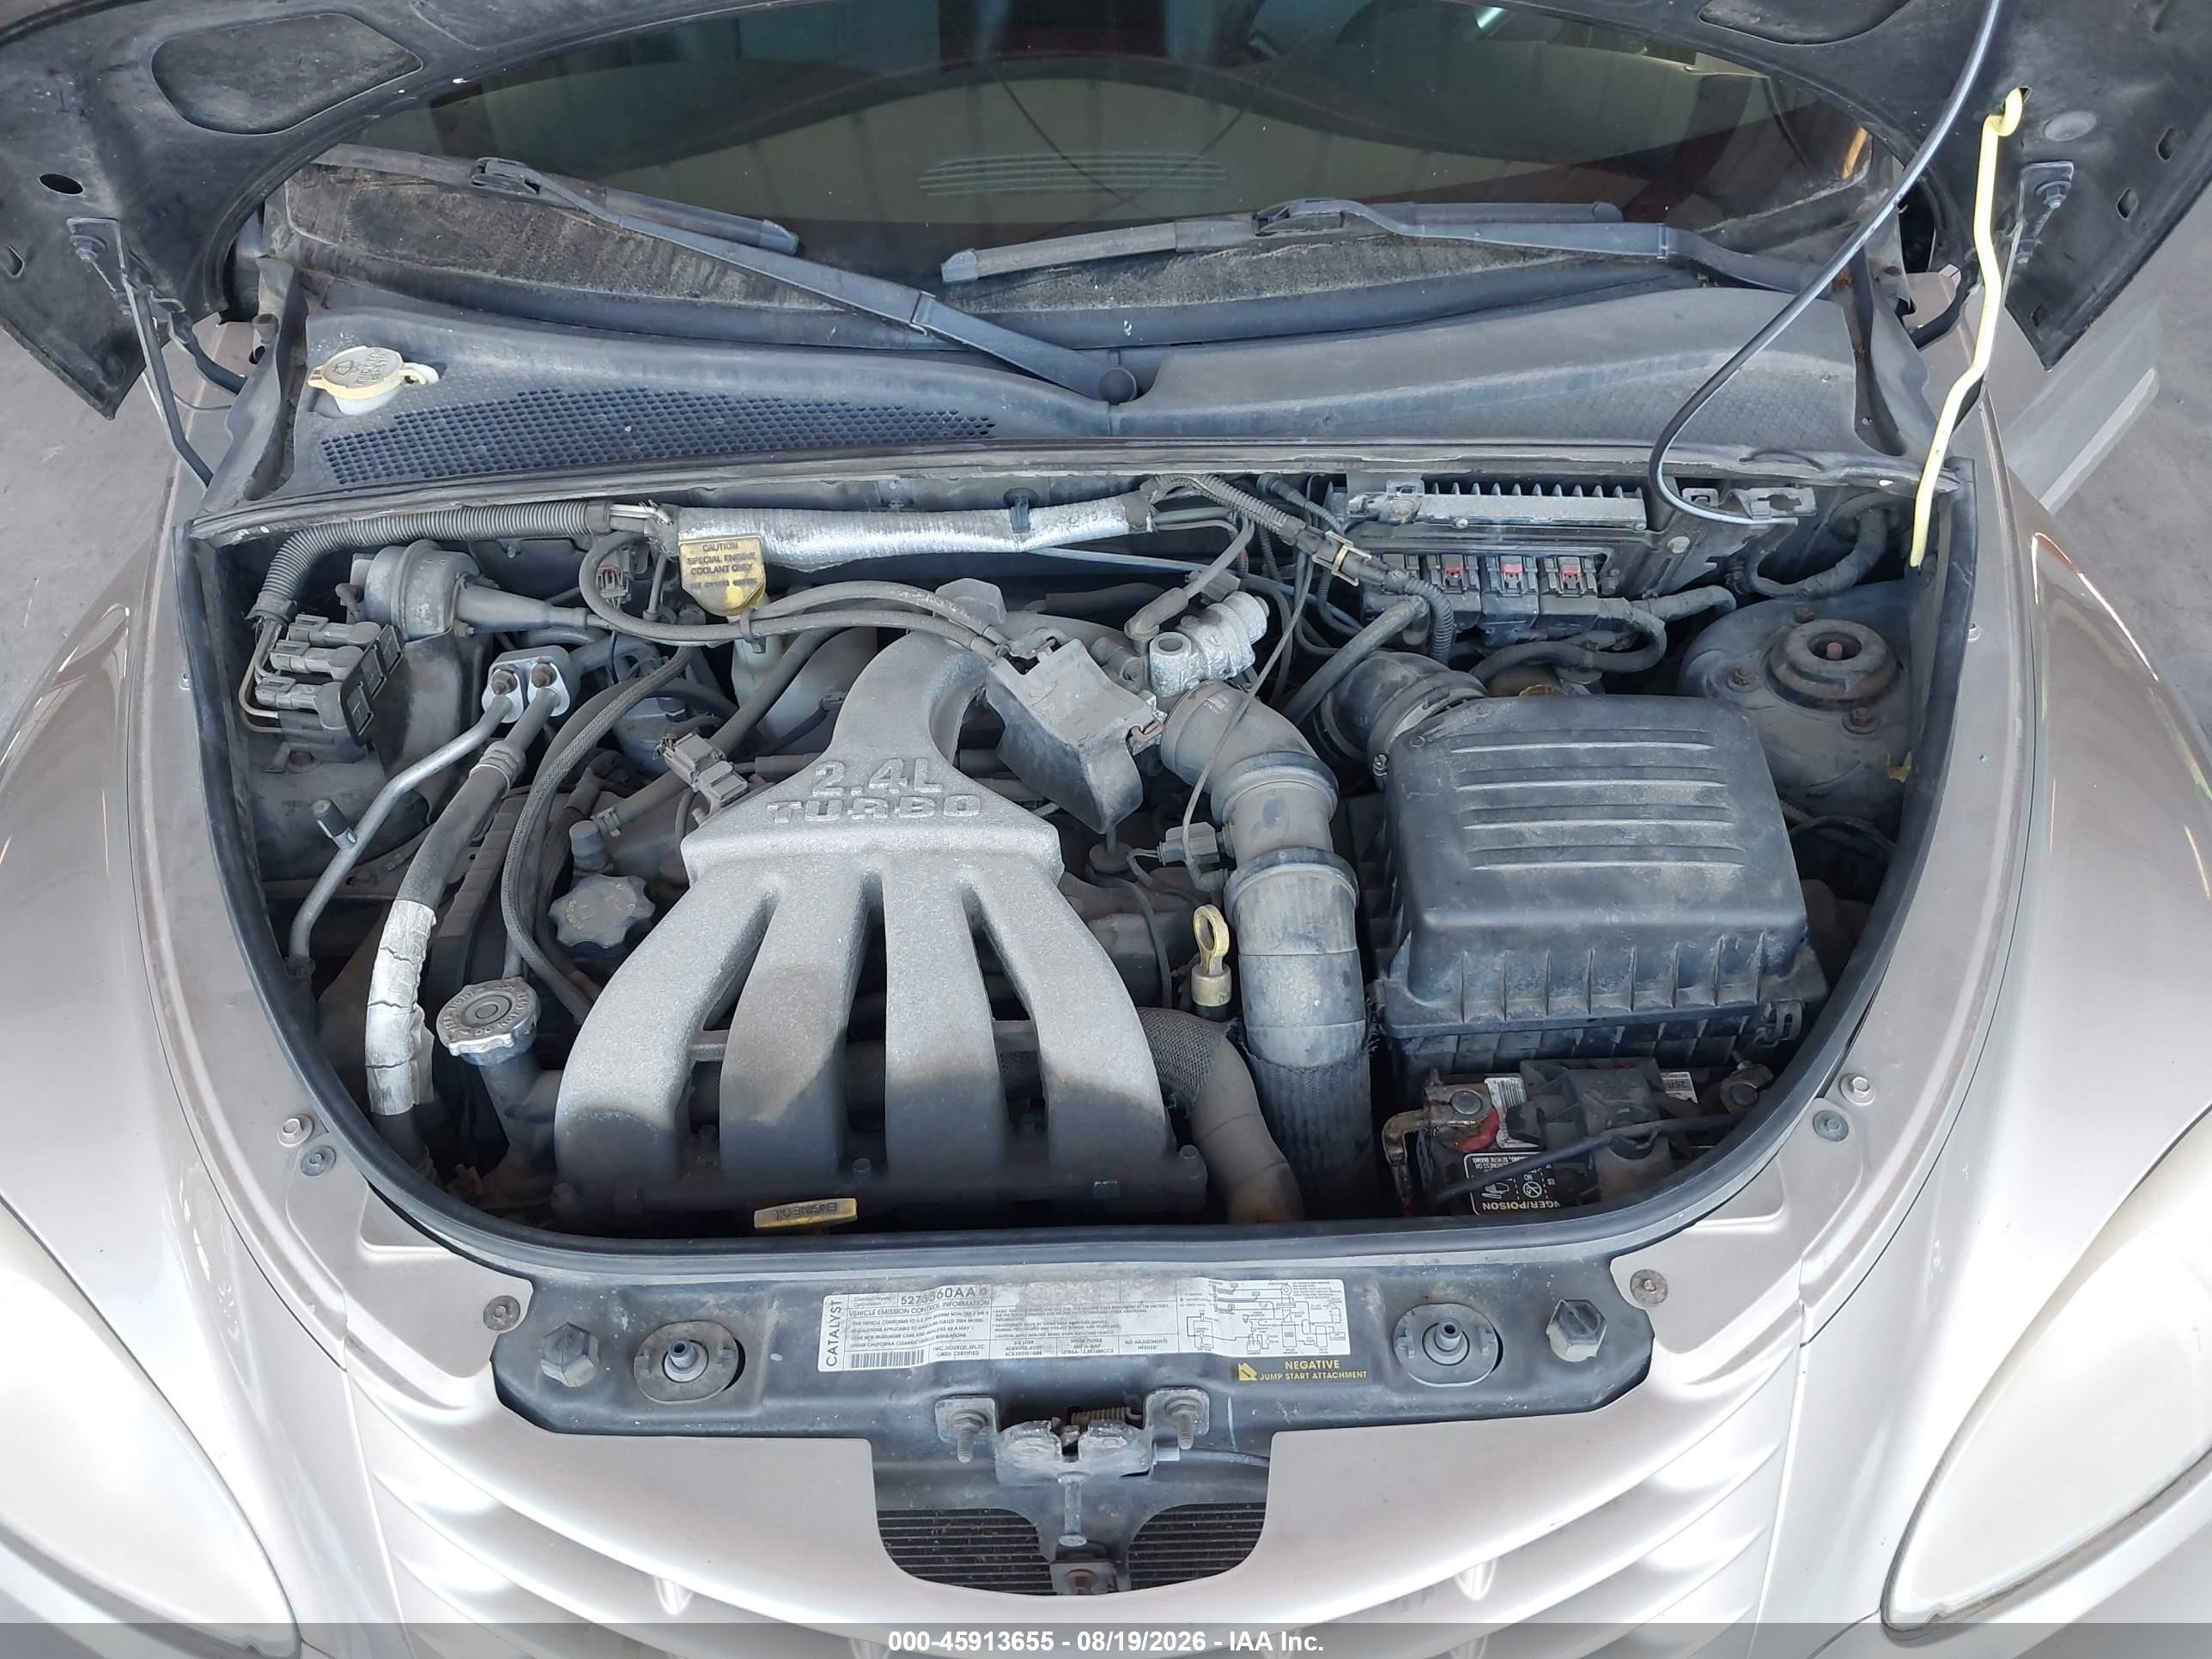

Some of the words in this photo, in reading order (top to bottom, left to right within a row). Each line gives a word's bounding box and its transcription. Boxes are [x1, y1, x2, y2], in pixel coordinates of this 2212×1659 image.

[702, 542, 738, 551] CAUTION
[687, 556, 722, 565] SPECIAL
[724, 551, 756, 562] ENGINE
[690, 566, 729, 575] COOLANT
[731, 562, 753, 572] ONLY
[812, 757, 944, 797] 2.4L
[767, 795, 981, 823] TURBO
[773, 1208, 790, 1221] OIL
[793, 1203, 839, 1217] ENGINE
[911, 1303, 940, 1314] CONTROL
[825, 1299, 842, 1367] CATALYST
[1285, 1359, 1340, 1370] NEGATIVE
[1285, 1372, 1310, 1381] START
[1311, 1370, 1367, 1380] ATTACHMENT
